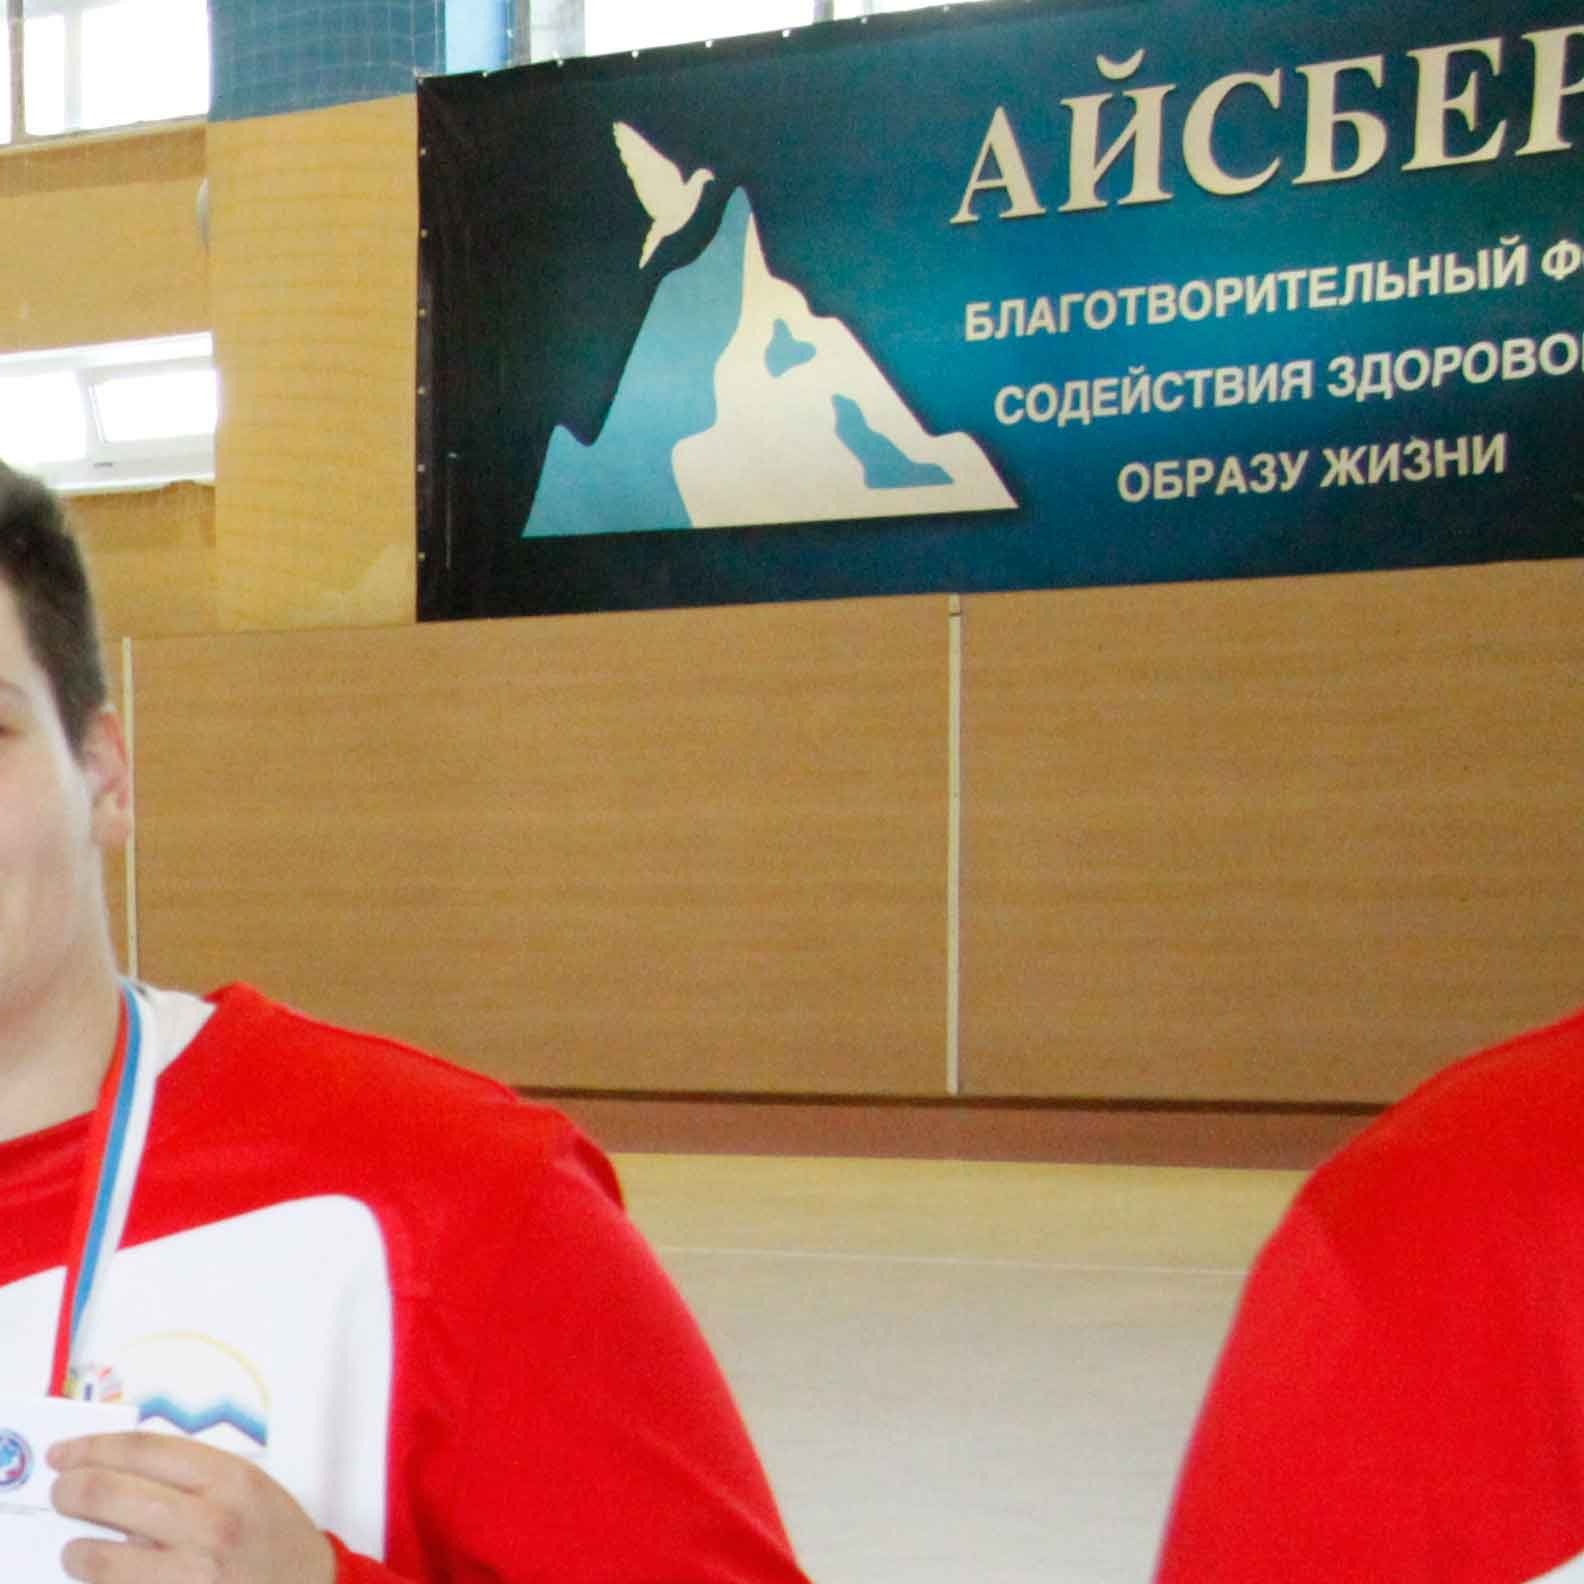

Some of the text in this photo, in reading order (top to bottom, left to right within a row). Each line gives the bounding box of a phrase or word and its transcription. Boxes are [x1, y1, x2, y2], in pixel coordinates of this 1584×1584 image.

[964, 234, 1529, 342] БЛАГОТВОРИТЕЛЬНЫЙ
[994, 332, 1584, 427] СОДЕЙСТВИЯ ЗДОРОВО
[1117, 433, 1508, 503] ОБРАЗУ ЖИЗНИ
